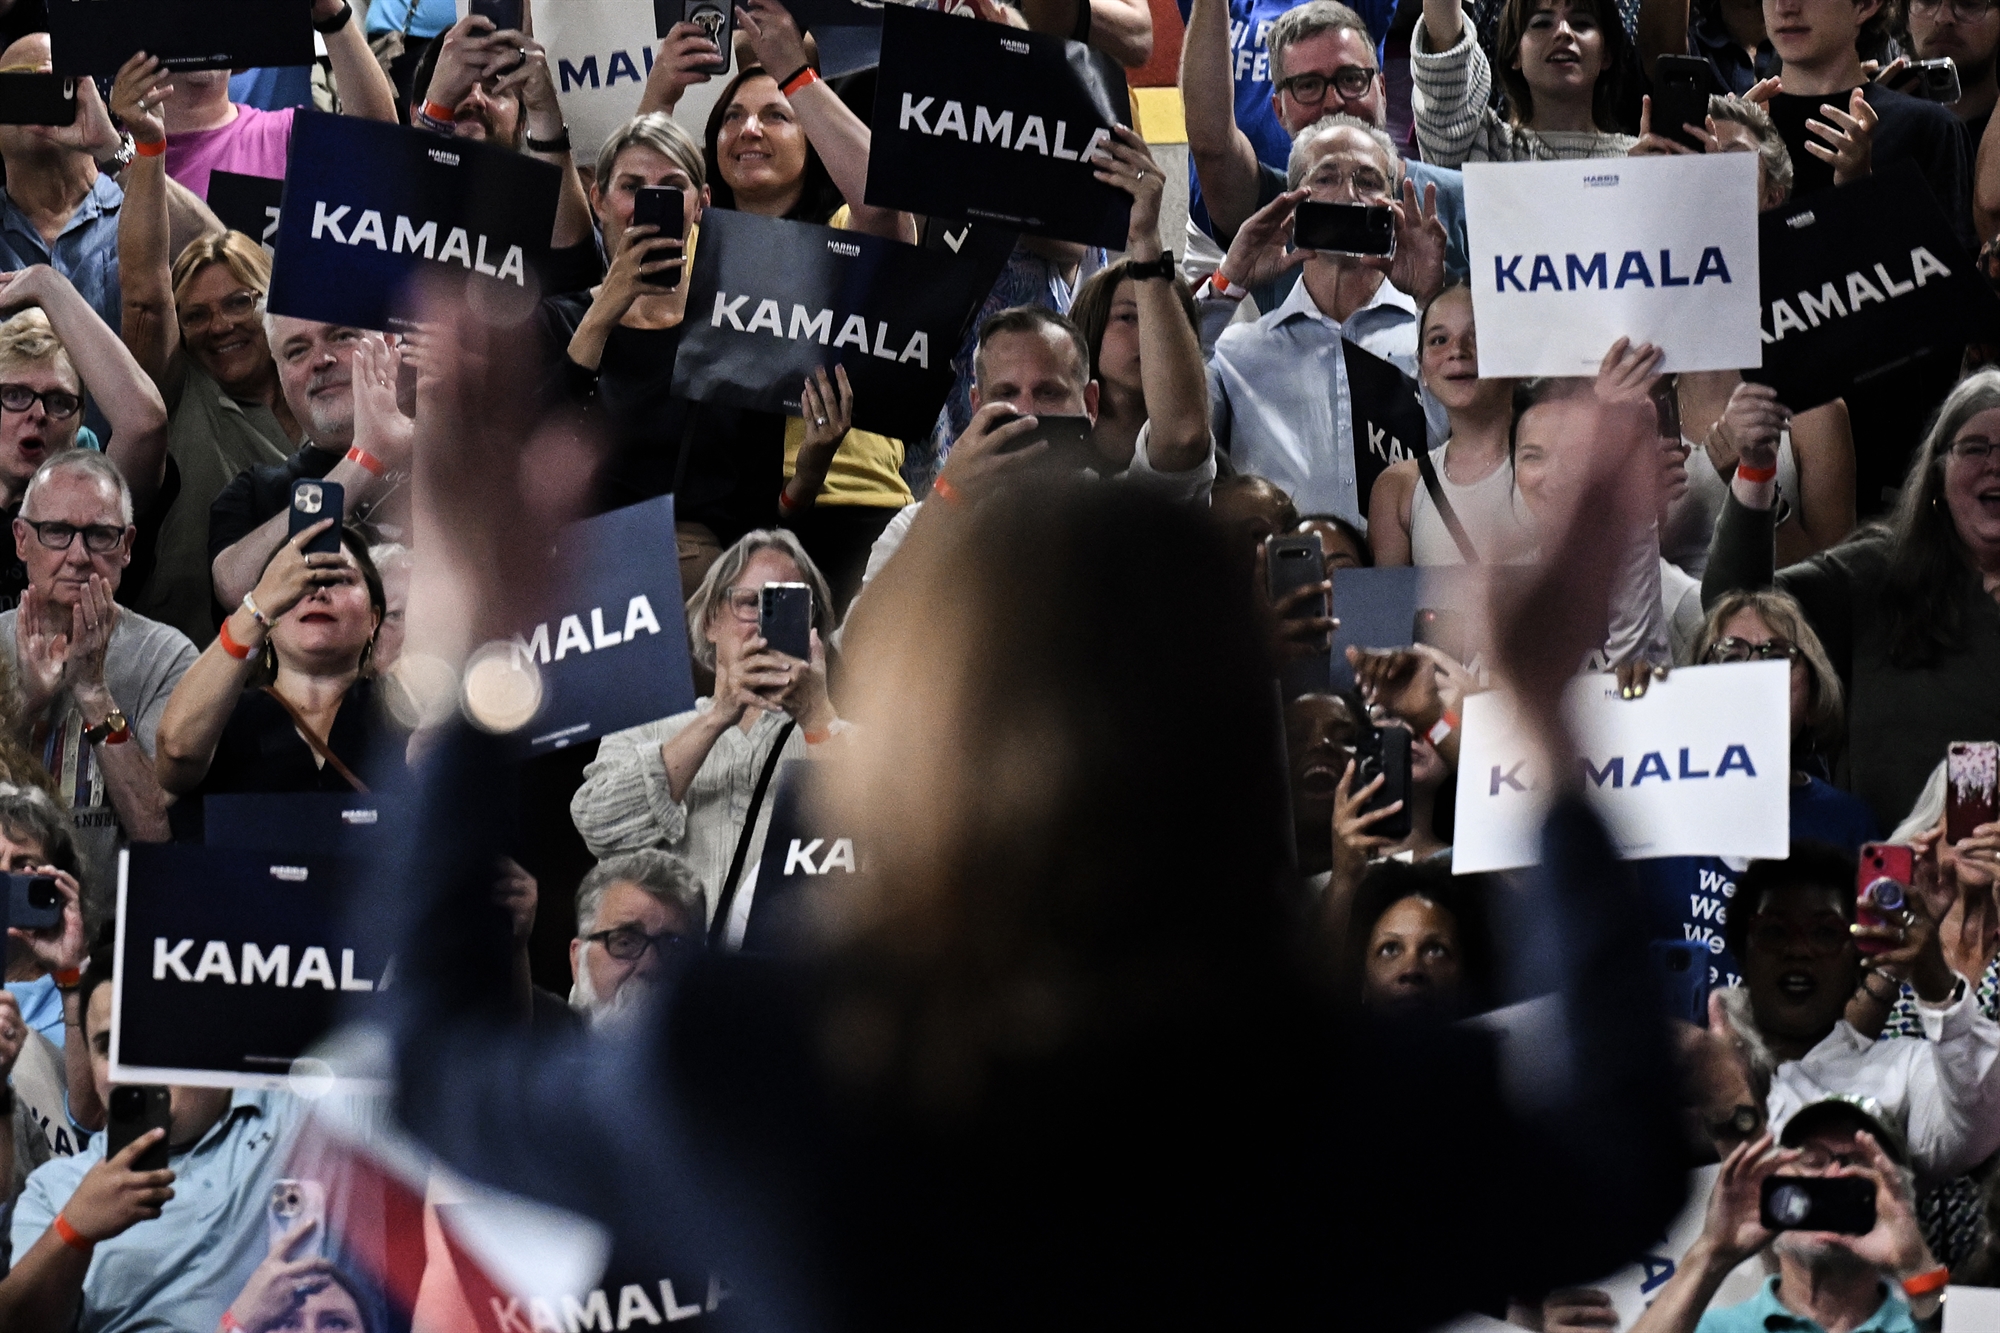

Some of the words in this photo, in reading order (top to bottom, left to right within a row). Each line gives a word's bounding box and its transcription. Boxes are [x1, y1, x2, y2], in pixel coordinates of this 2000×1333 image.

[310, 200, 525, 287] KAMALA
[1494, 246, 1733, 293] KAMALA
[711, 290, 929, 370] KAMALA
[1489, 744, 1757, 797] KMALA
[1699, 868, 1737, 898] We
